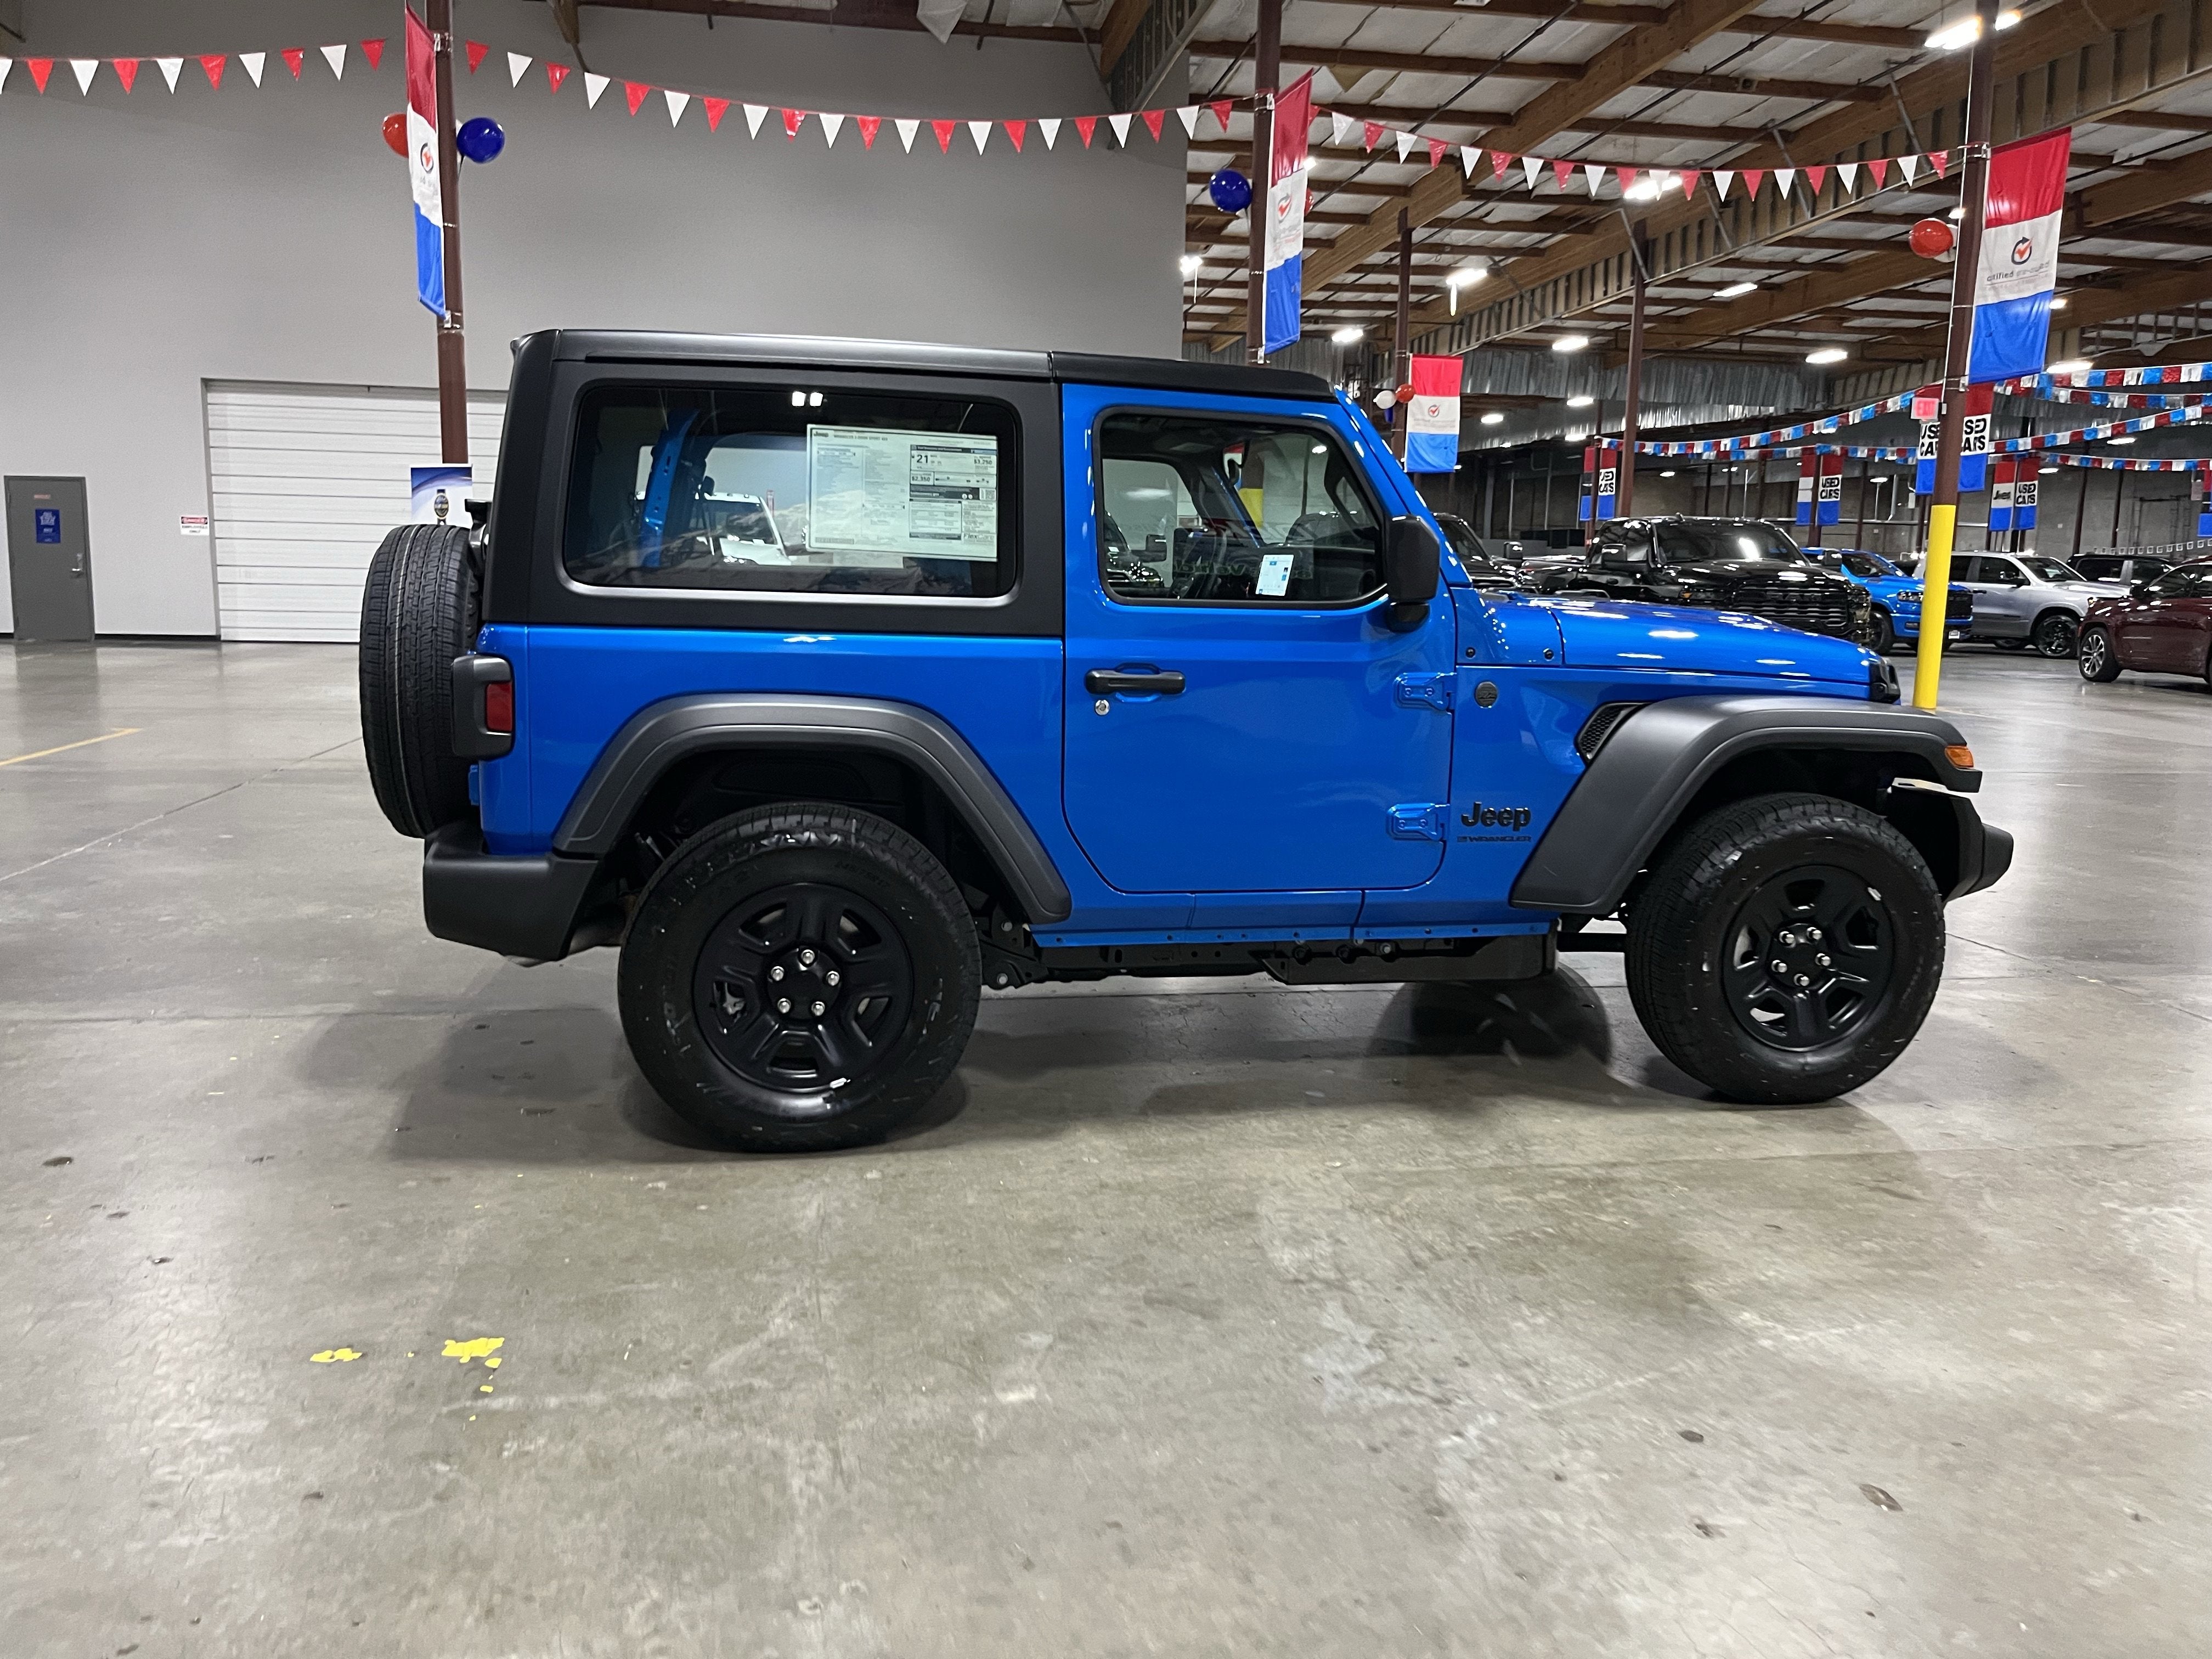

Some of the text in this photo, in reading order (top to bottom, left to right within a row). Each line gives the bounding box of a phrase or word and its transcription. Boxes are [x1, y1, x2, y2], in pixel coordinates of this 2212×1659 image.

[1964, 418, 1987, 435] SED
[1962, 435, 1985, 452] ARS
[916, 454, 928, 464] 21
[1461, 802, 1532, 832] Jeep
